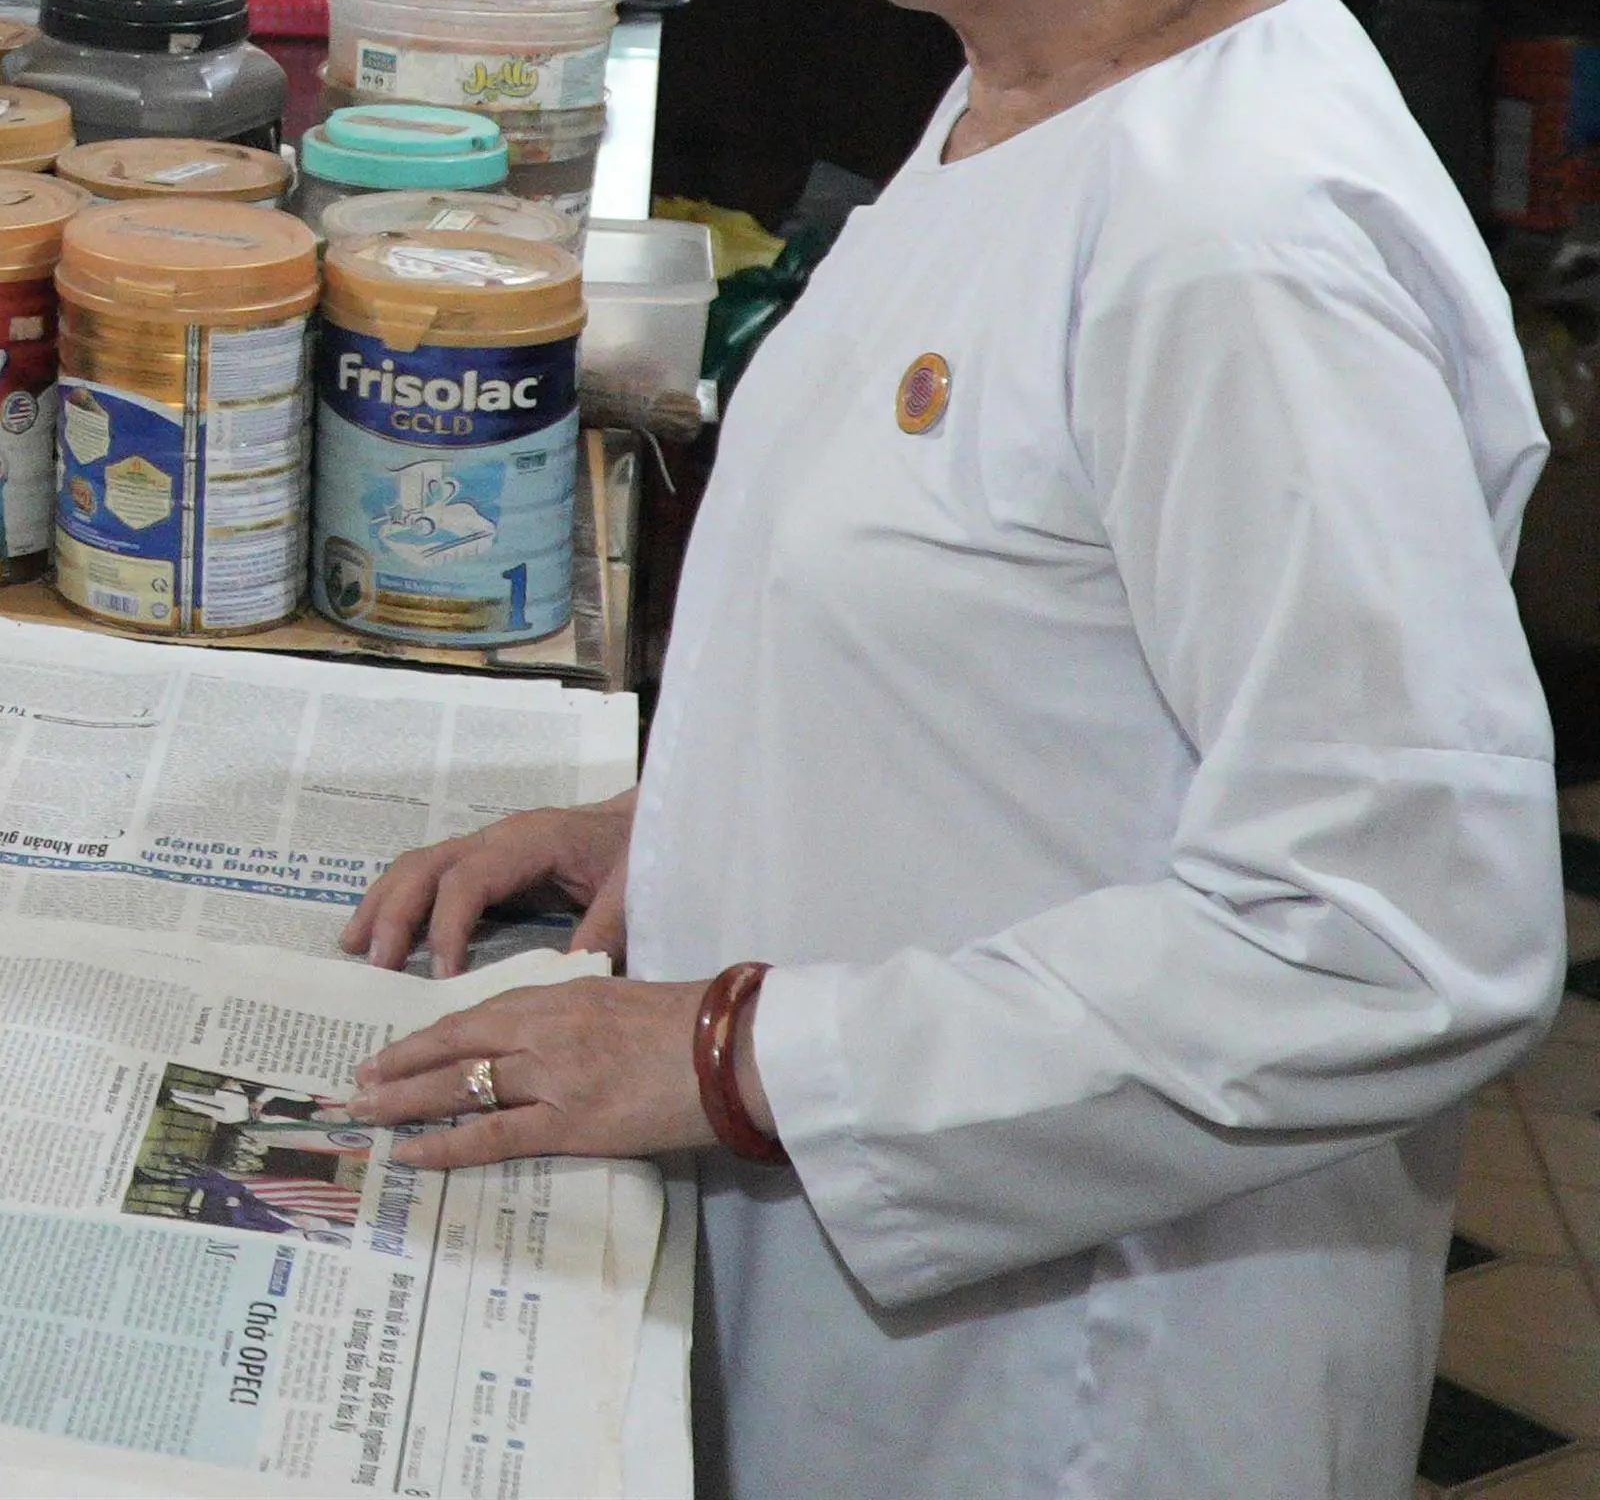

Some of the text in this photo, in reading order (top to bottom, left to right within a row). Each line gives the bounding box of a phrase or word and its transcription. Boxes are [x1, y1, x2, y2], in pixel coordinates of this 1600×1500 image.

[461, 60, 540, 98] Jelly
[338, 352, 540, 414] Frisolac
[391, 409, 475, 437] GOLD
[502, 562, 535, 633] 1
[222, 857, 301, 881] không
[229, 1345, 269, 1407] OPEC!
